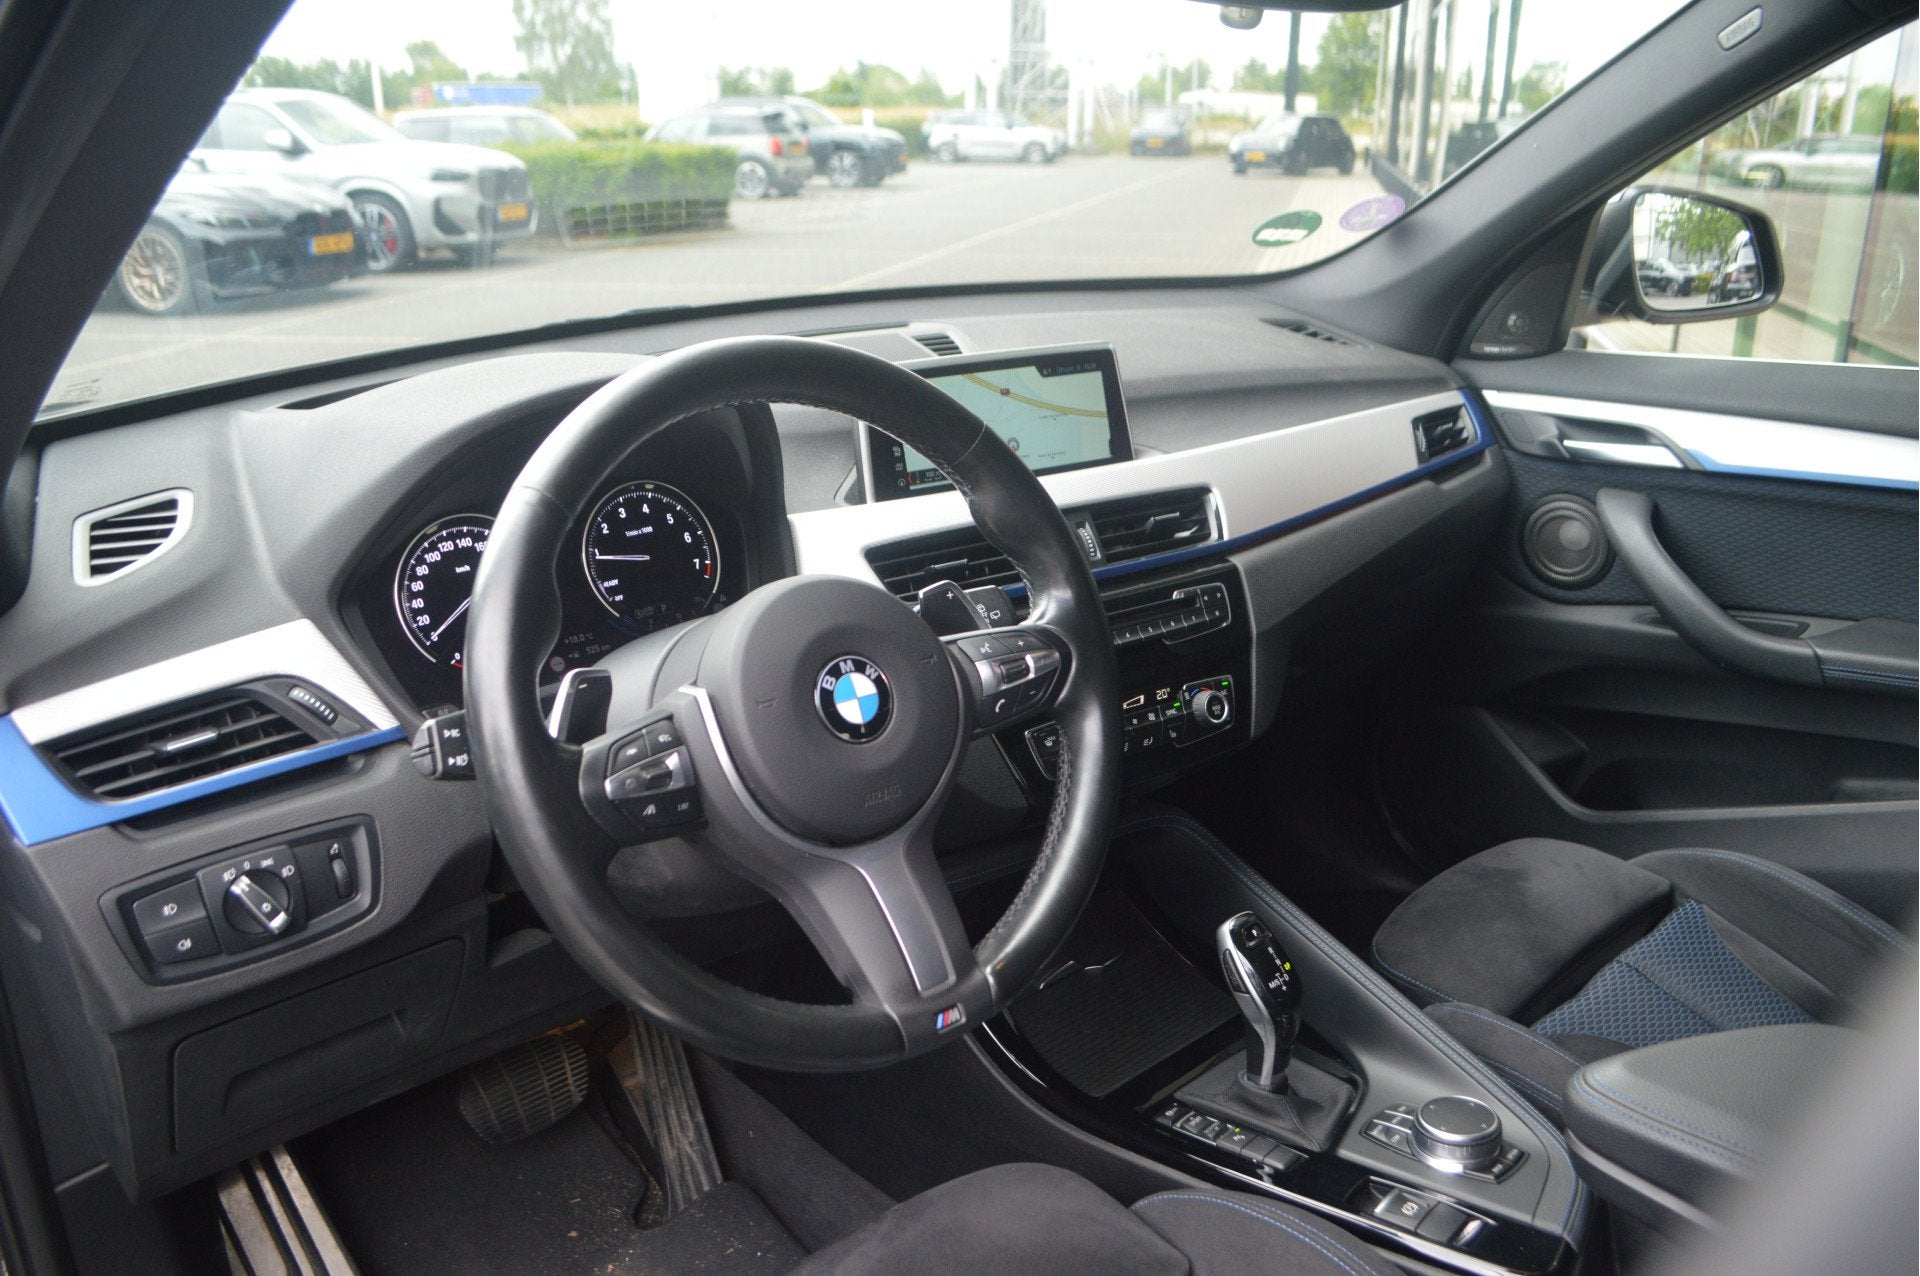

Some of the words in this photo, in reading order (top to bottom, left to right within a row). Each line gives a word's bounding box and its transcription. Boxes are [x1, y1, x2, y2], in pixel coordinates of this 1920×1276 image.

[618, 507, 627, 519] 3
[642, 503, 650, 514] 4
[666, 513, 674, 524] 5
[601, 523, 610, 534] 2
[455, 537, 473, 549] 140
[683, 531, 692, 543] 6
[437, 540, 455, 553] 120
[424, 550, 441, 564] 100
[455, 564, 471, 574] km/h
[692, 558, 700, 570] 7
[415, 564, 429, 577] 80
[410, 580, 424, 592] 60
[411, 598, 424, 609] 40
[416, 614, 431, 626] 20
[564, 633, 586, 645] +18.0
[454, 652, 461, 660] 0
[586, 645, 601, 655] 525
[821, 659, 880, 691] BMW
[1251, 929, 1258, 937] P
[1283, 973, 1289, 981] D
